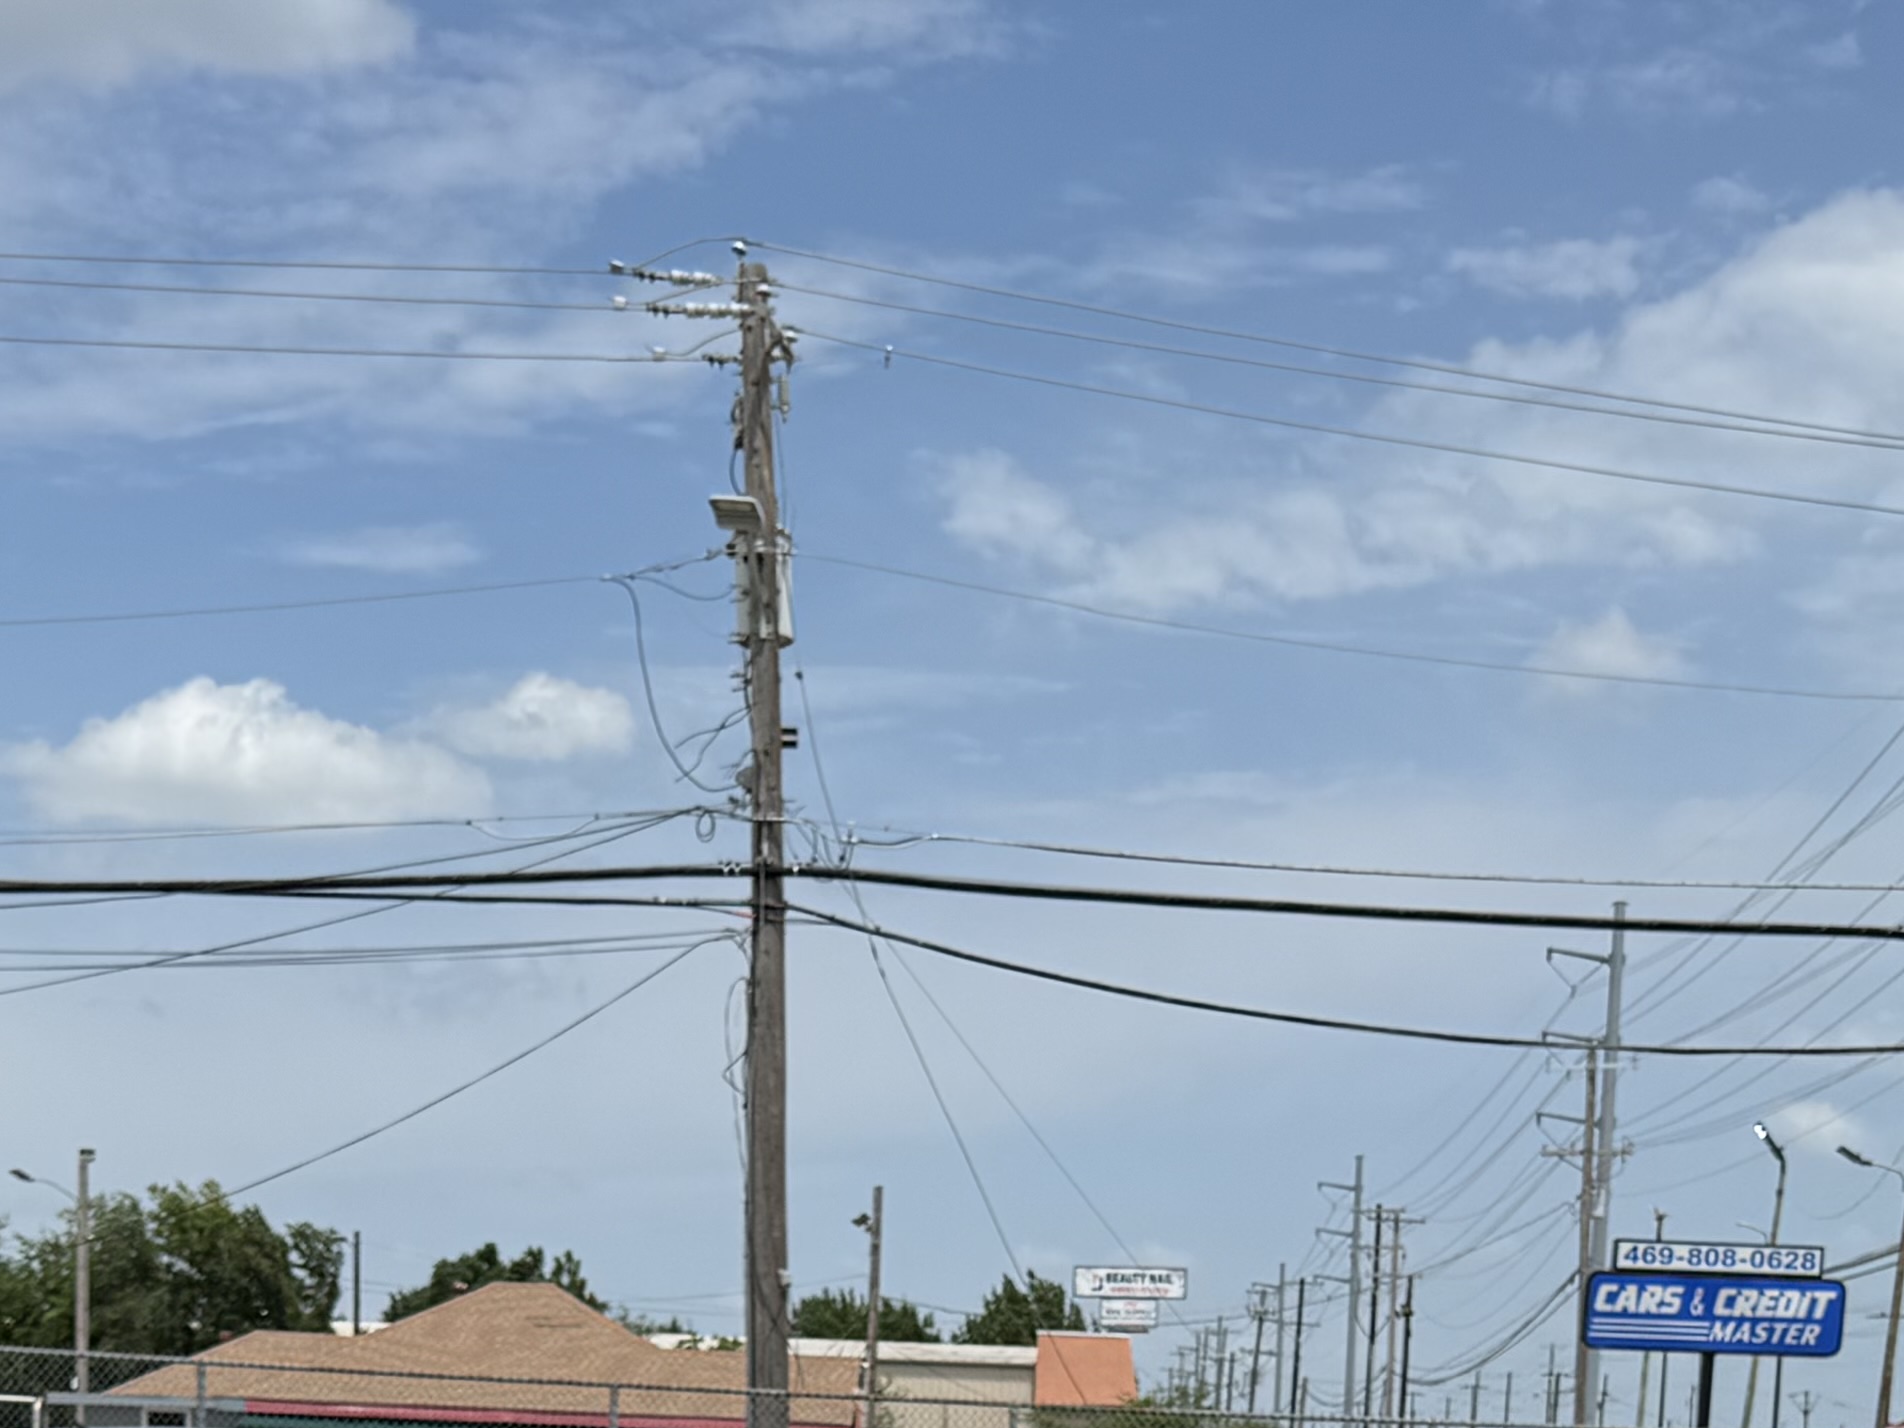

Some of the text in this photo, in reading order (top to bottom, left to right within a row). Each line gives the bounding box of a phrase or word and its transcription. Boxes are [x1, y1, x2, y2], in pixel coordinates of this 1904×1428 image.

[1624, 1245, 1817, 1272] 469-808-0628
[1593, 1284, 1836, 1320] CARS & CREDIT
[1708, 1321, 1822, 1346] MASTER
